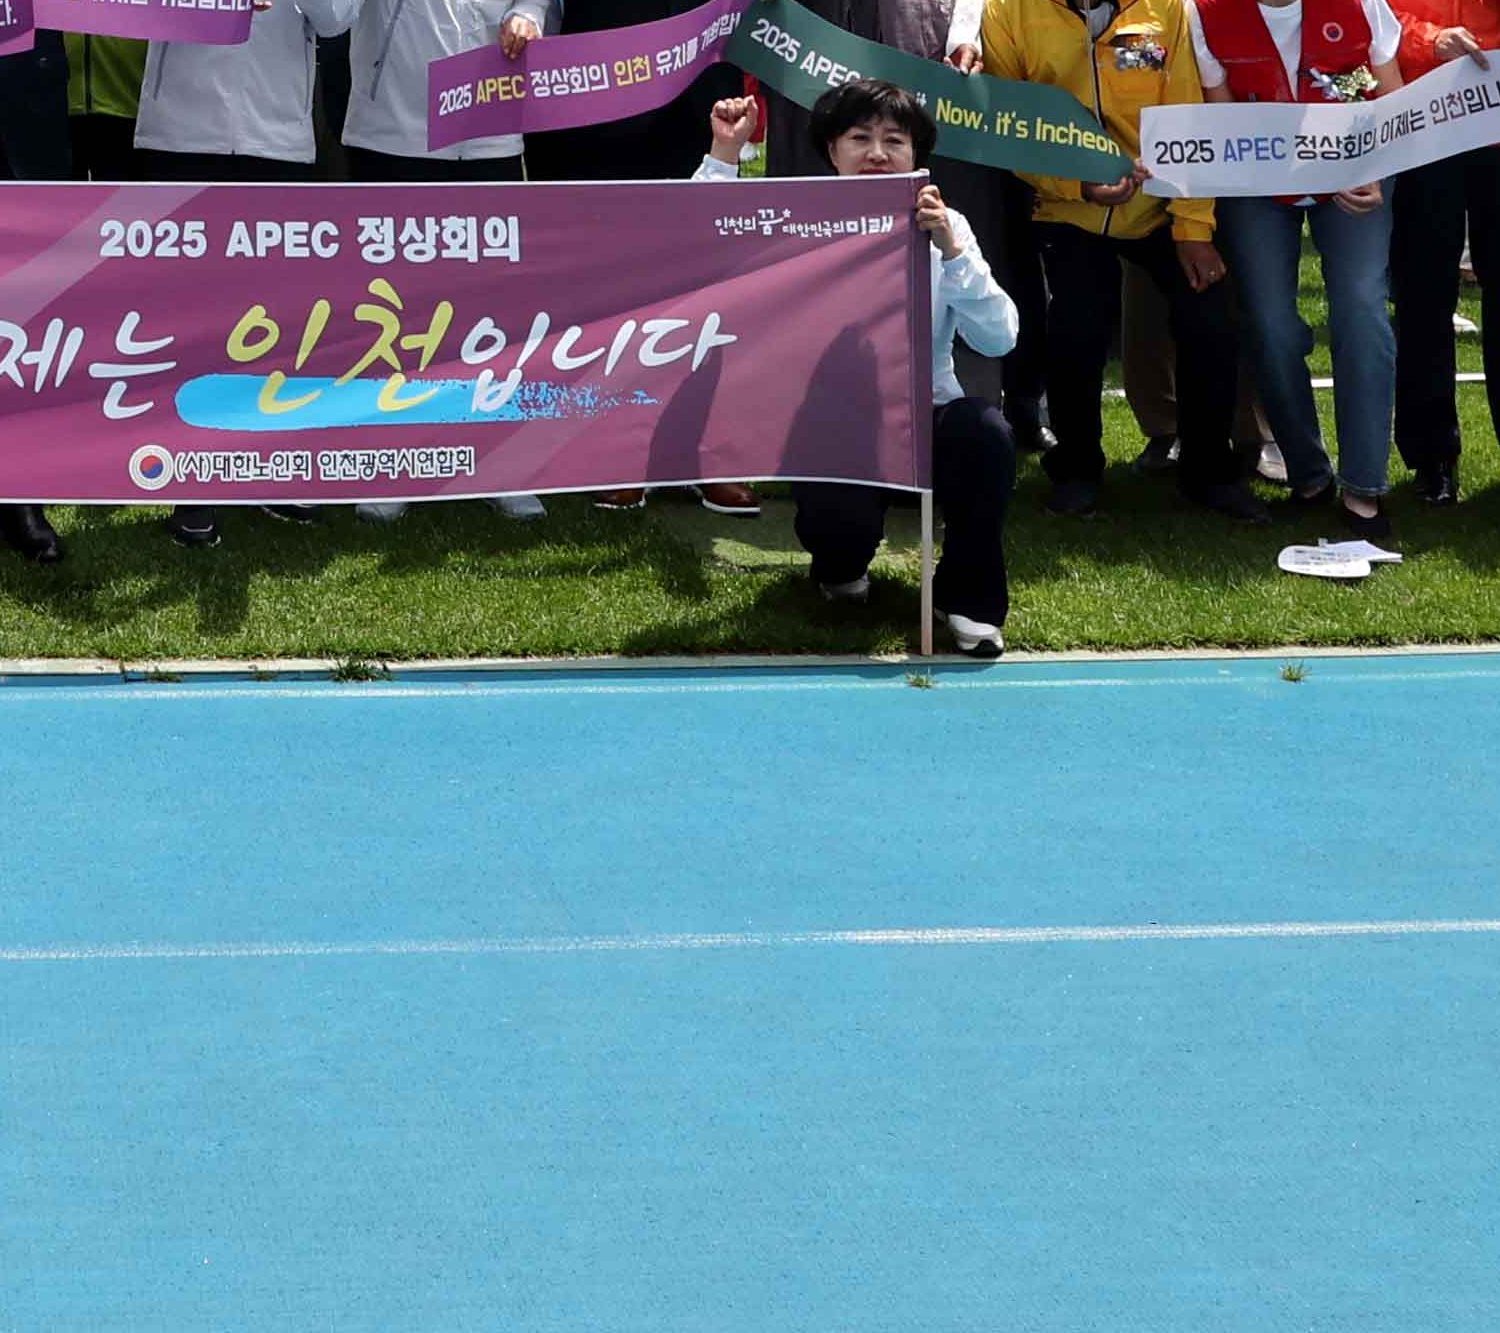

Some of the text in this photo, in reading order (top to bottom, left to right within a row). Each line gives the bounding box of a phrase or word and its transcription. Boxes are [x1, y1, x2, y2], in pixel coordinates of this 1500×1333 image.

[439, 42, 698, 116] 2025 APEC 정상회의 인천 유치를
[750, 18, 1121, 157] 2025 Now, it's Incheon
[1155, 138, 1215, 164] 2025
[1223, 137, 1286, 162] APEC
[1295, 127, 1377, 161] 정상회의
[1380, 109, 1425, 146] 이제는
[100, 215, 521, 264] 2025 APEC 정상회의
[715, 216, 756, 235] 인천의
[758, 209, 784, 236] 꿈
[226, 277, 738, 414] 인천입니다
[174, 446, 476, 483] (사)대한노인회 인천광역시연합회
